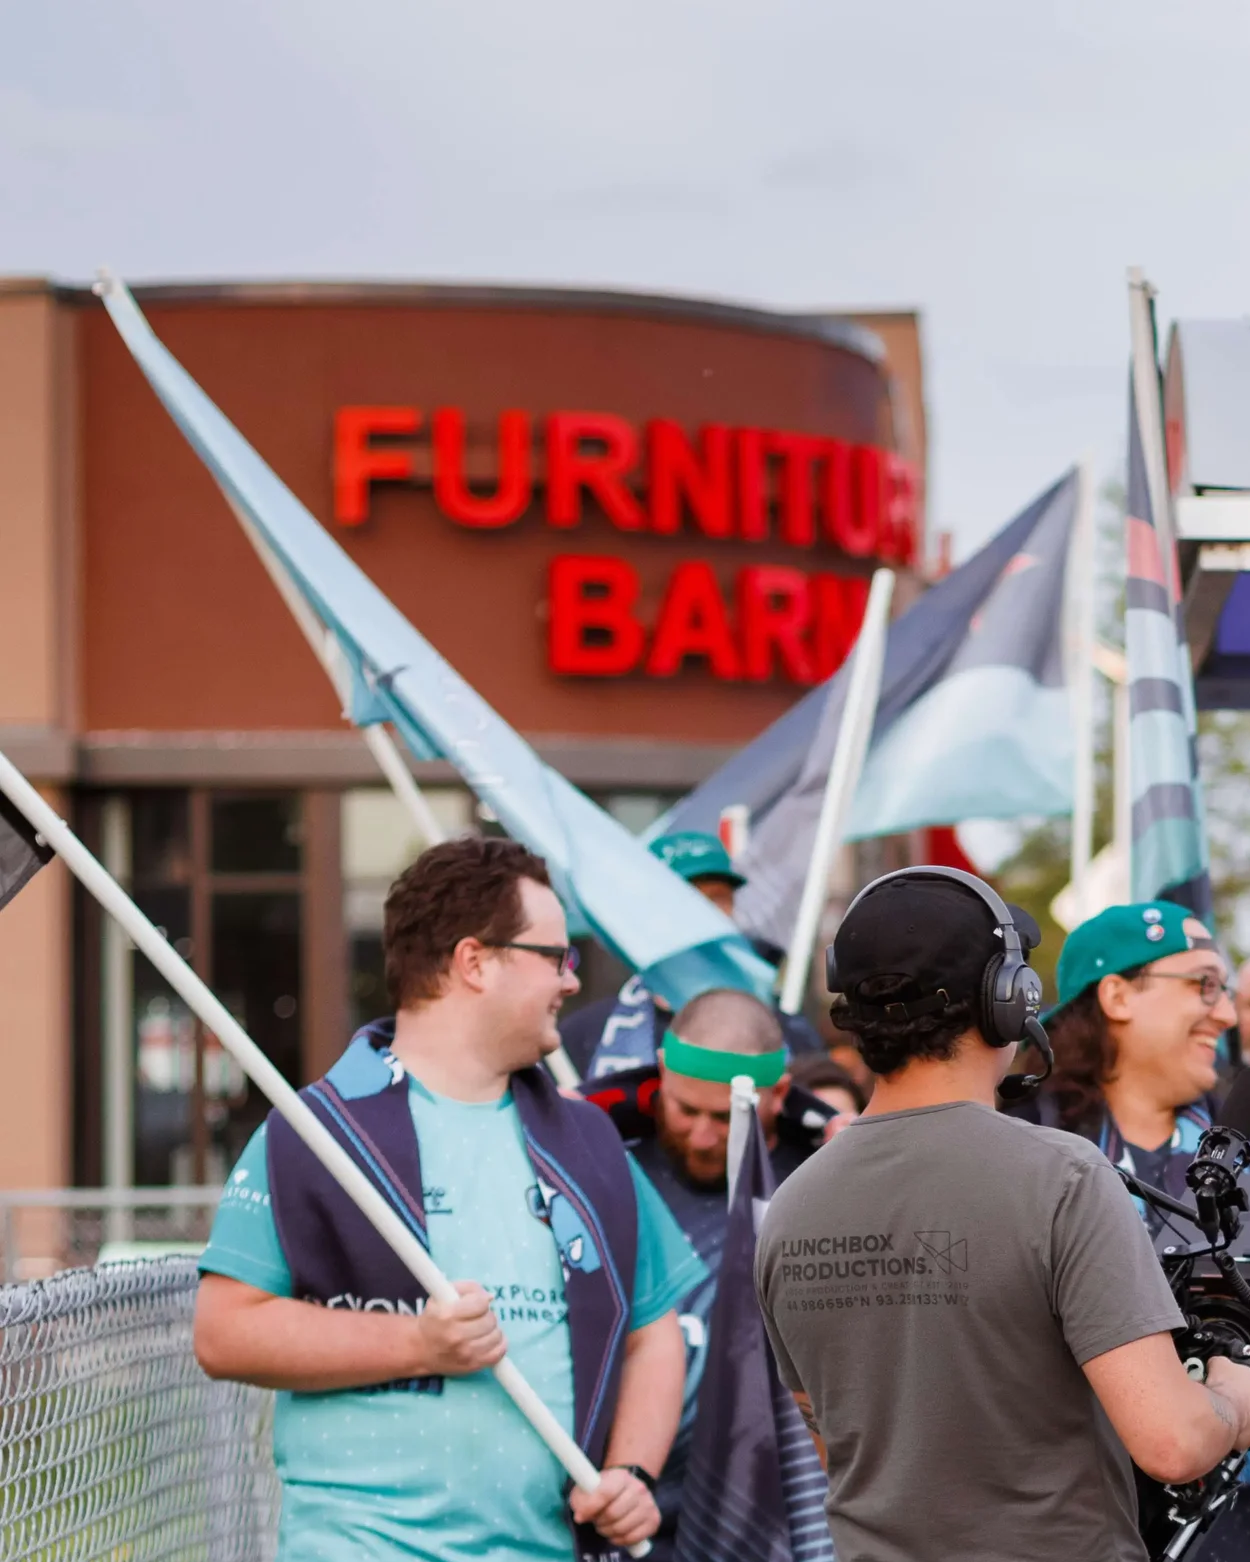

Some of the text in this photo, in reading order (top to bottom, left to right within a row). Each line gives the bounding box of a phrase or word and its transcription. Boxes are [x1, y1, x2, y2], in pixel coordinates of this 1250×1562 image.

[332, 403, 920, 565] FURNITUR
[781, 1233, 895, 1258] LUNCHBOX
[782, 1256, 933, 1283] PRODUCTIONS.
